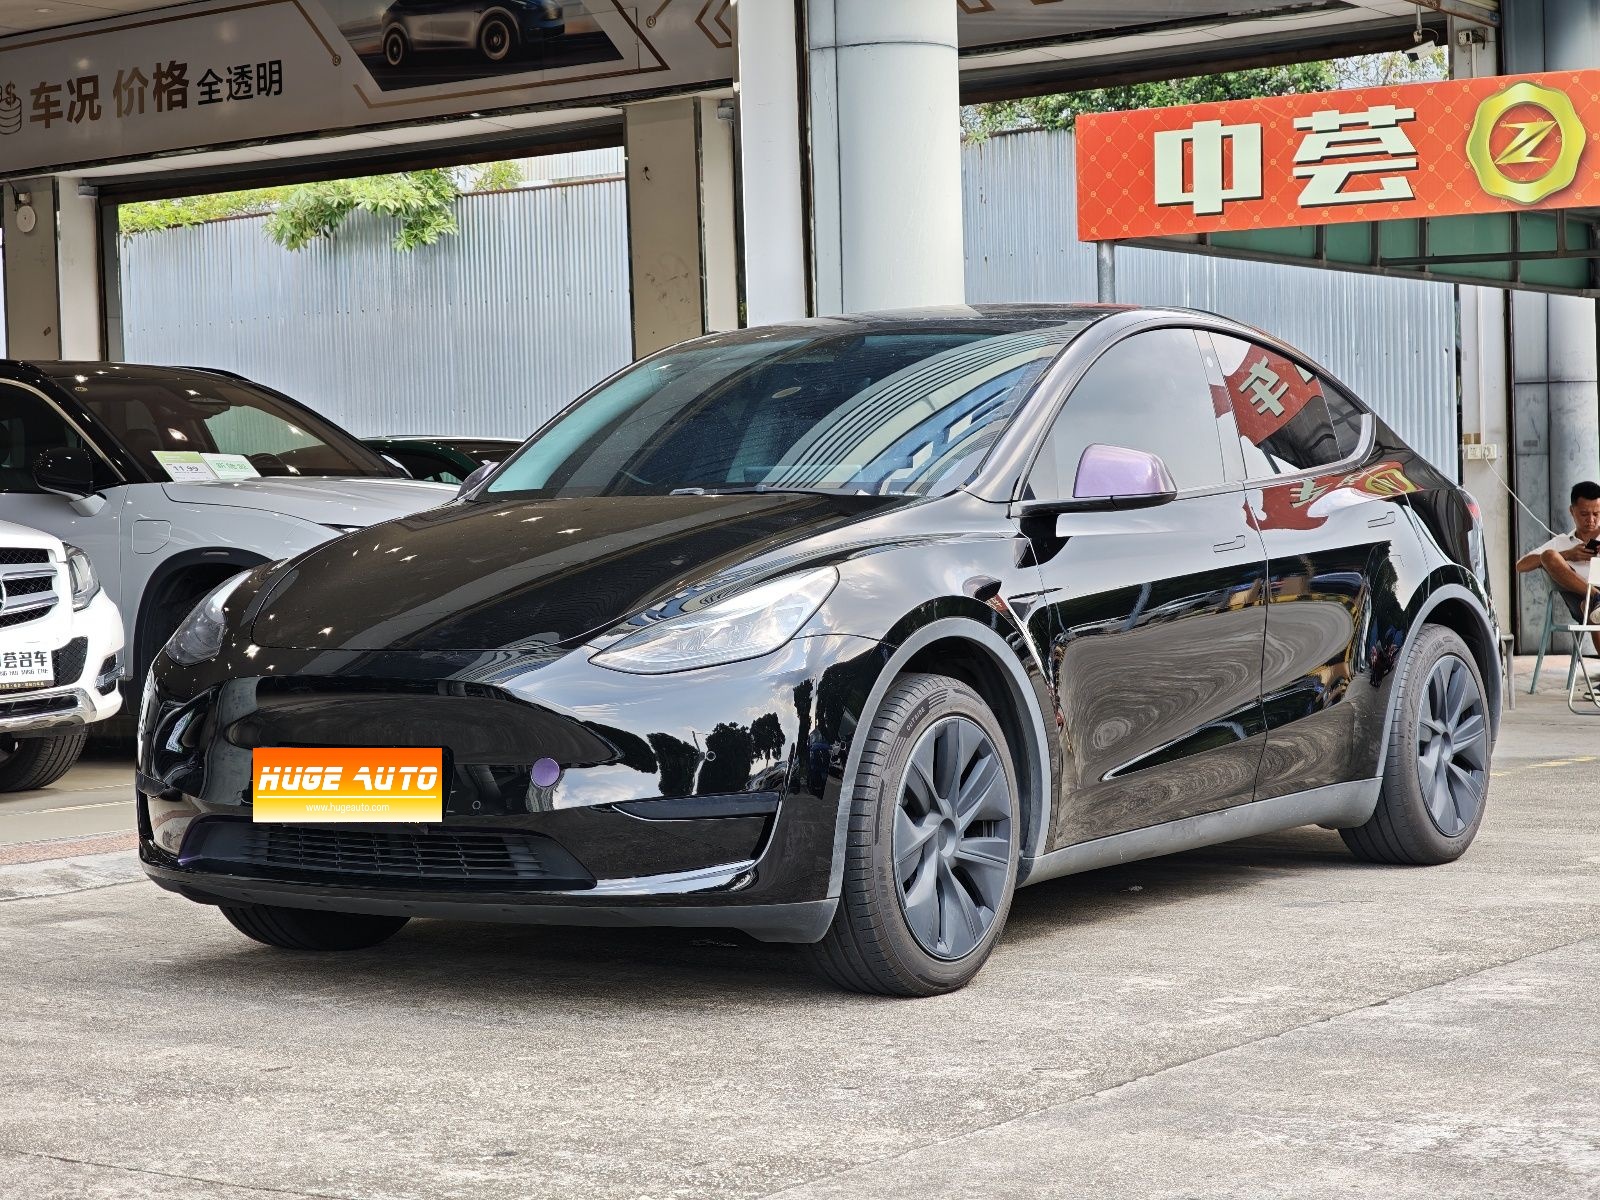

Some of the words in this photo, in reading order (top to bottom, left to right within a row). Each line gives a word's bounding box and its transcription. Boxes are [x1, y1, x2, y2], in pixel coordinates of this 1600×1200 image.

[30, 75, 102, 129] 车况
[113, 60, 189, 118] 价格
[197, 59, 283, 106] 全透明
[1154, 105, 1419, 215] 中荟
[0, 650, 48, 669] 荟名车
[906, 706, 926, 731] OUTSIDE
